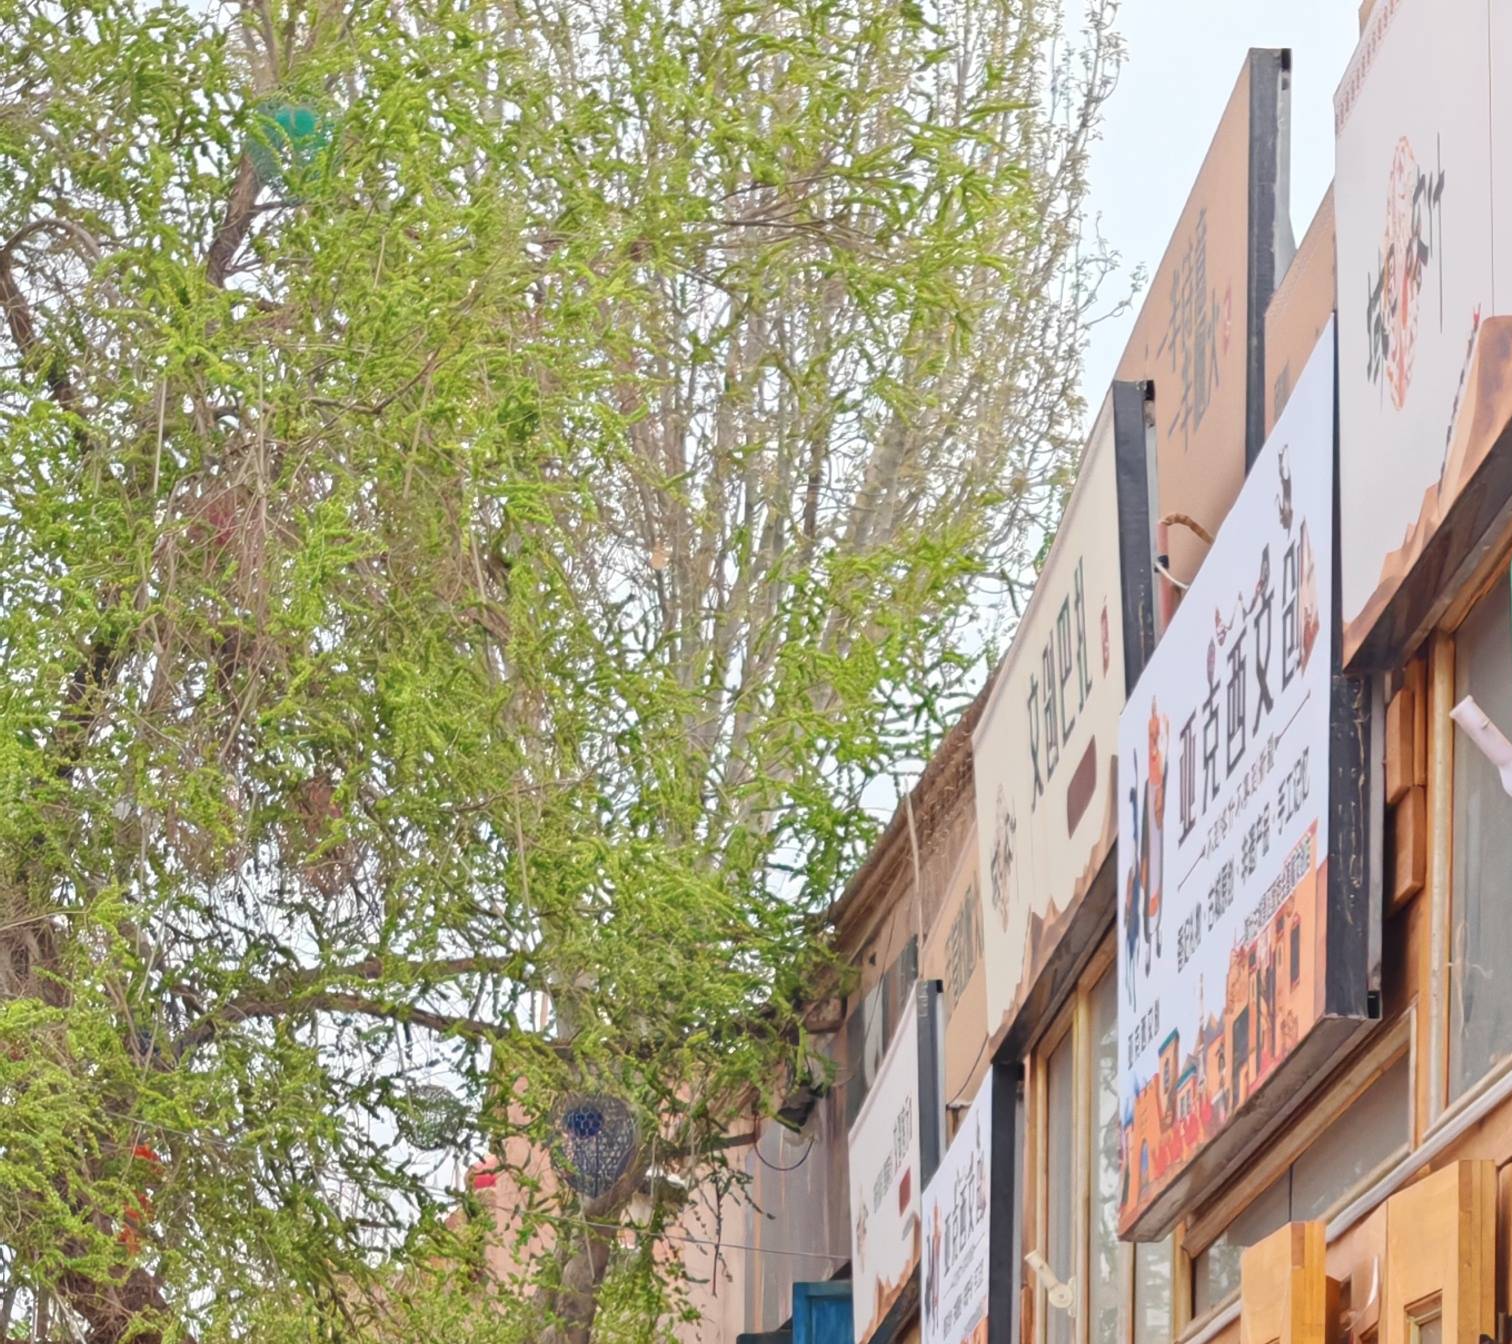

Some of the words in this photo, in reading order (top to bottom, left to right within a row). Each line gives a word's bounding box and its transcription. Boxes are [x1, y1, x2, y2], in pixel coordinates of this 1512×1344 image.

[1177, 518, 1308, 850] 亚克西文创
